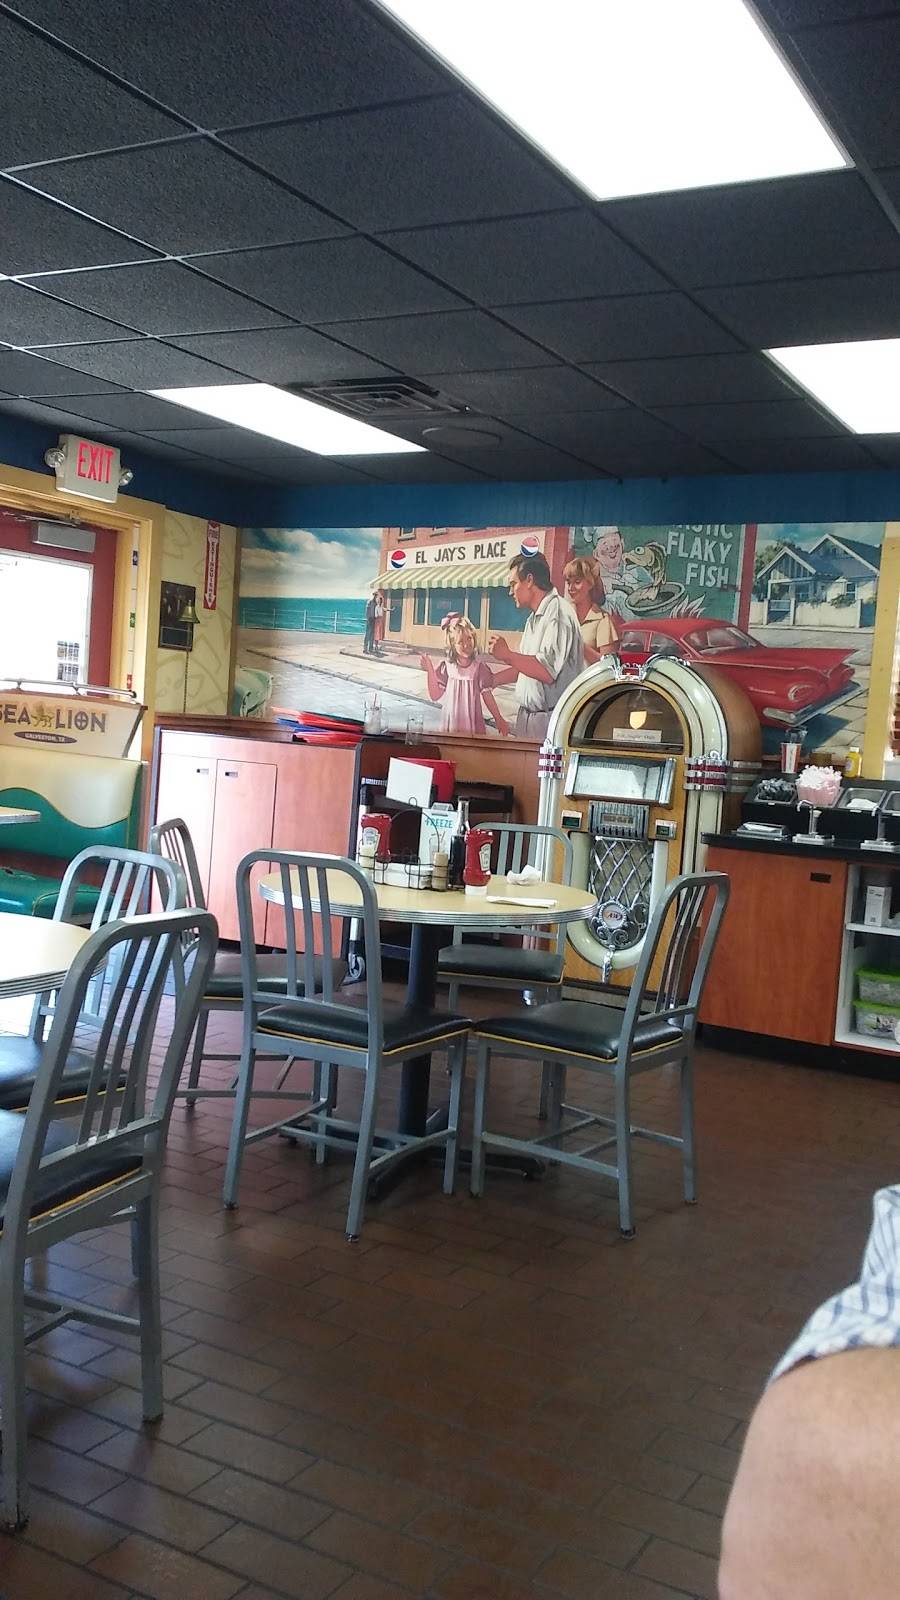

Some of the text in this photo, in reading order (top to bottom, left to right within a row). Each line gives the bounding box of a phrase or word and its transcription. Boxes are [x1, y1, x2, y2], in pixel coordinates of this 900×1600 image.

[78, 441, 114, 484] EXIT
[415, 541, 508, 565] EL JAY'S PLACE
[666, 531, 733, 565] FLAKY
[685, 562, 730, 589] FISH
[0, 704, 107, 733] EA LION
